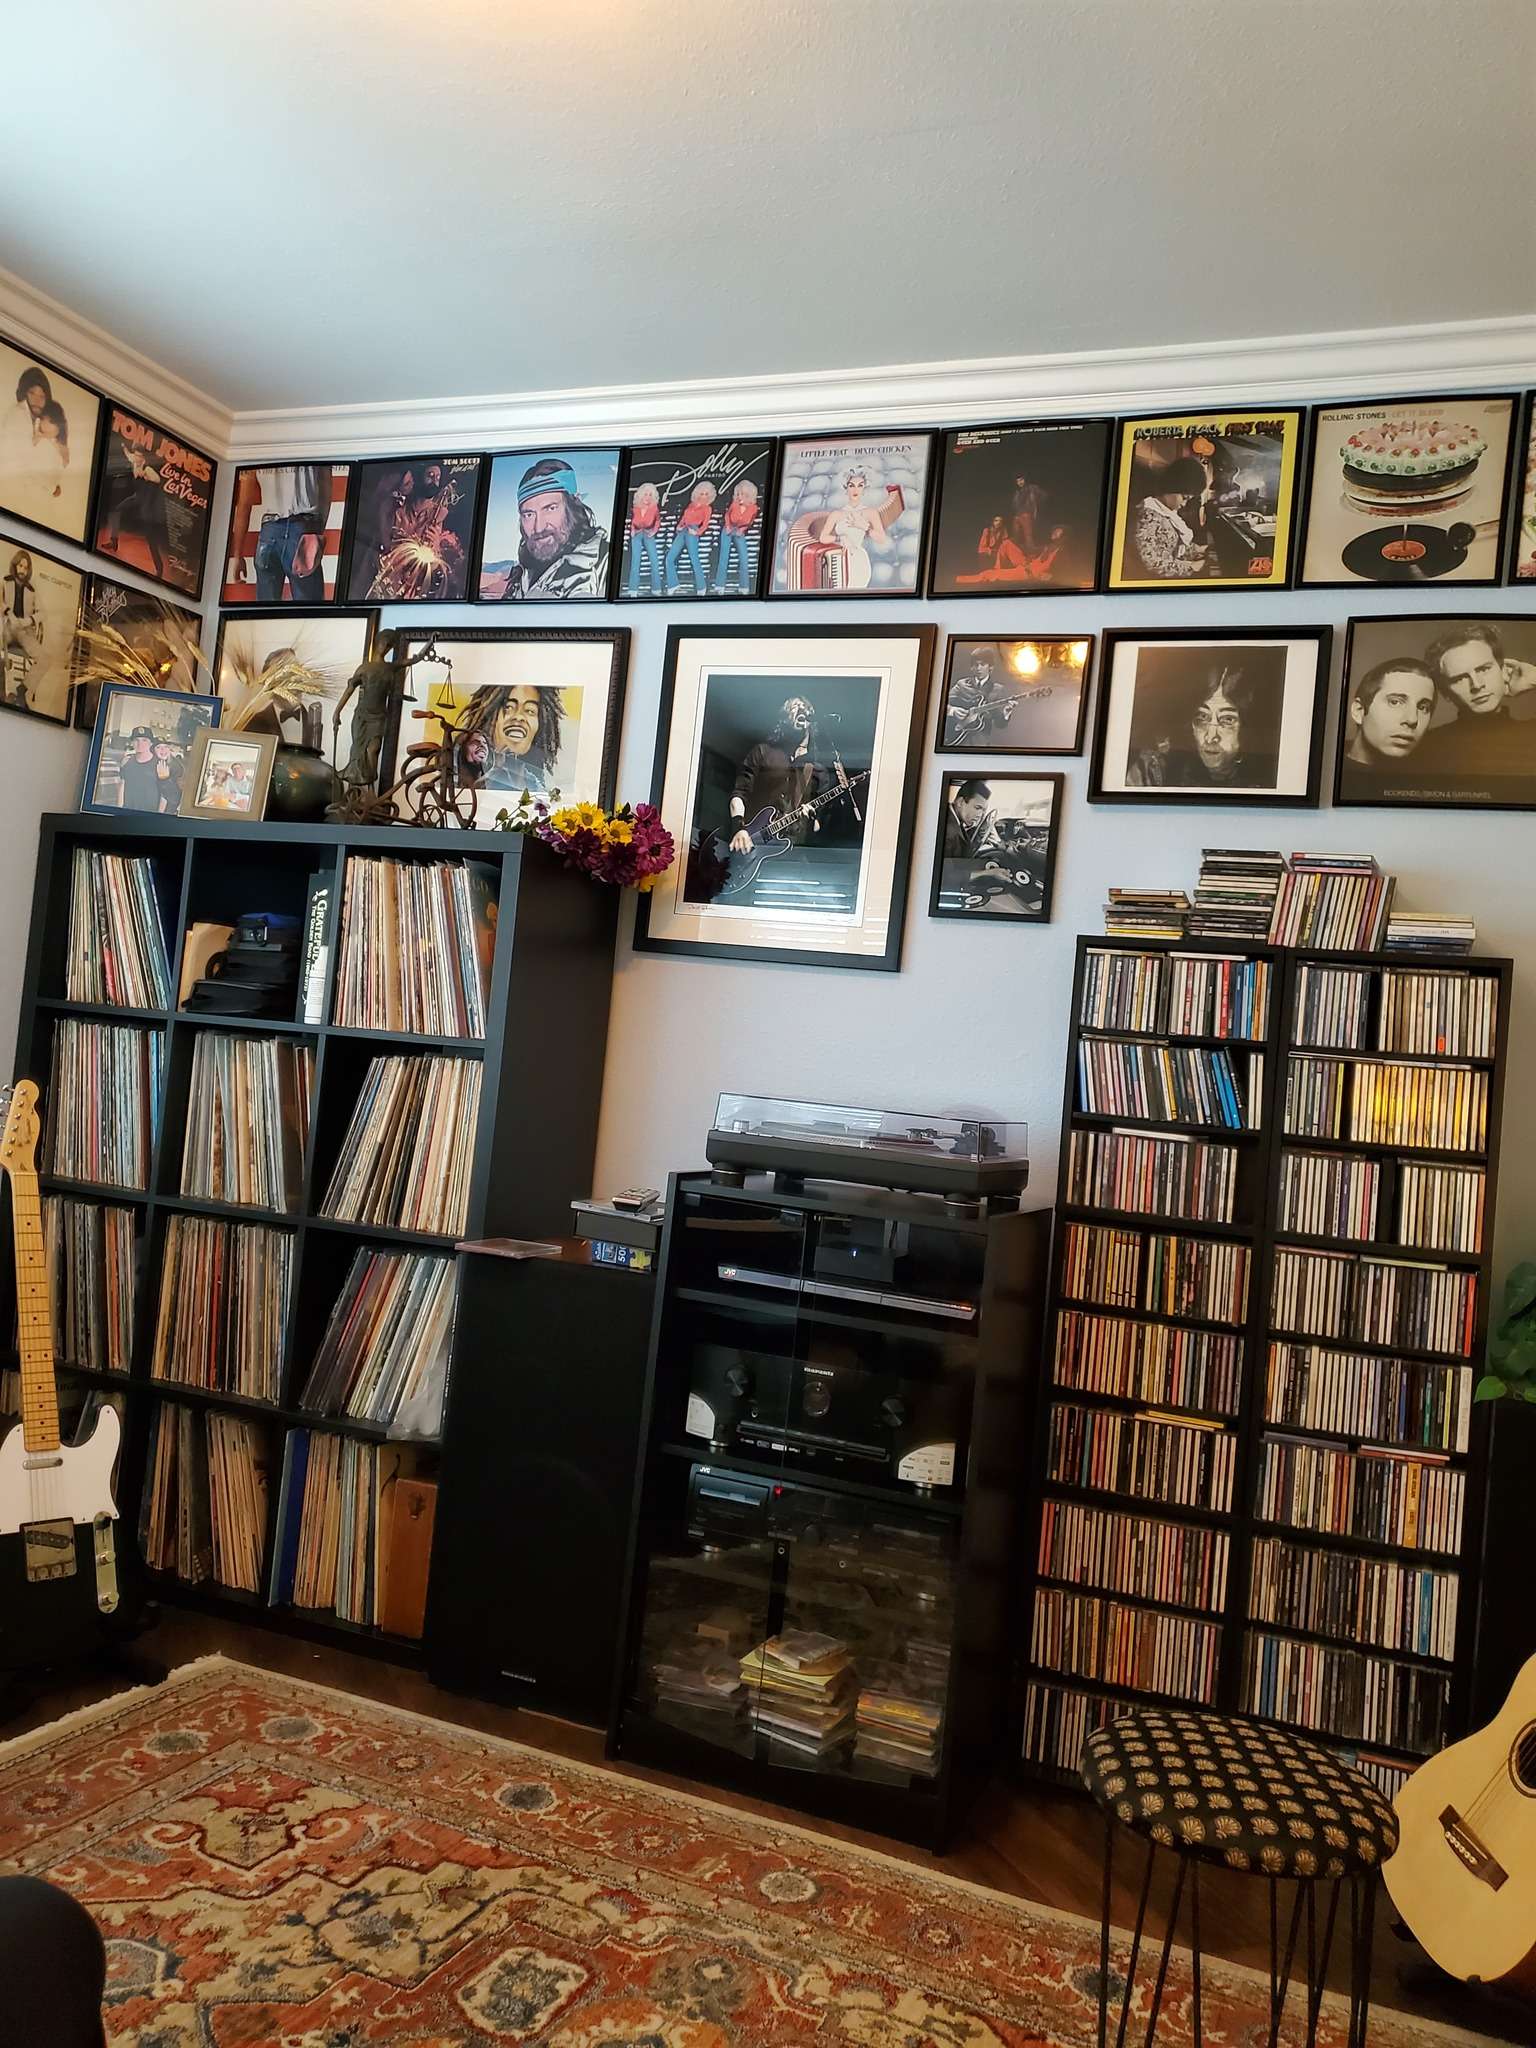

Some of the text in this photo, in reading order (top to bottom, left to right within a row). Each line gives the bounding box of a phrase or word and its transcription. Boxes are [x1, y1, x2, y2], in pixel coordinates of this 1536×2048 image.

[1134, 425, 1186, 438] ROBERTA
[1187, 423, 1221, 437] FLACK
[1226, 421, 1252, 435] FIRST
[1323, 412, 1354, 422] ROLLING
[1356, 411, 1386, 421] STONES
[112, 410, 213, 482] TOM JONES
[800, 444, 912, 459] LITTLE FEAT DIXIE CHICKEN
[160, 462, 192, 487] Live in
[629, 443, 769, 507] Dolly
[163, 478, 208, 509] Las Vegas
[312, 899, 327, 960] GRATEFUL
